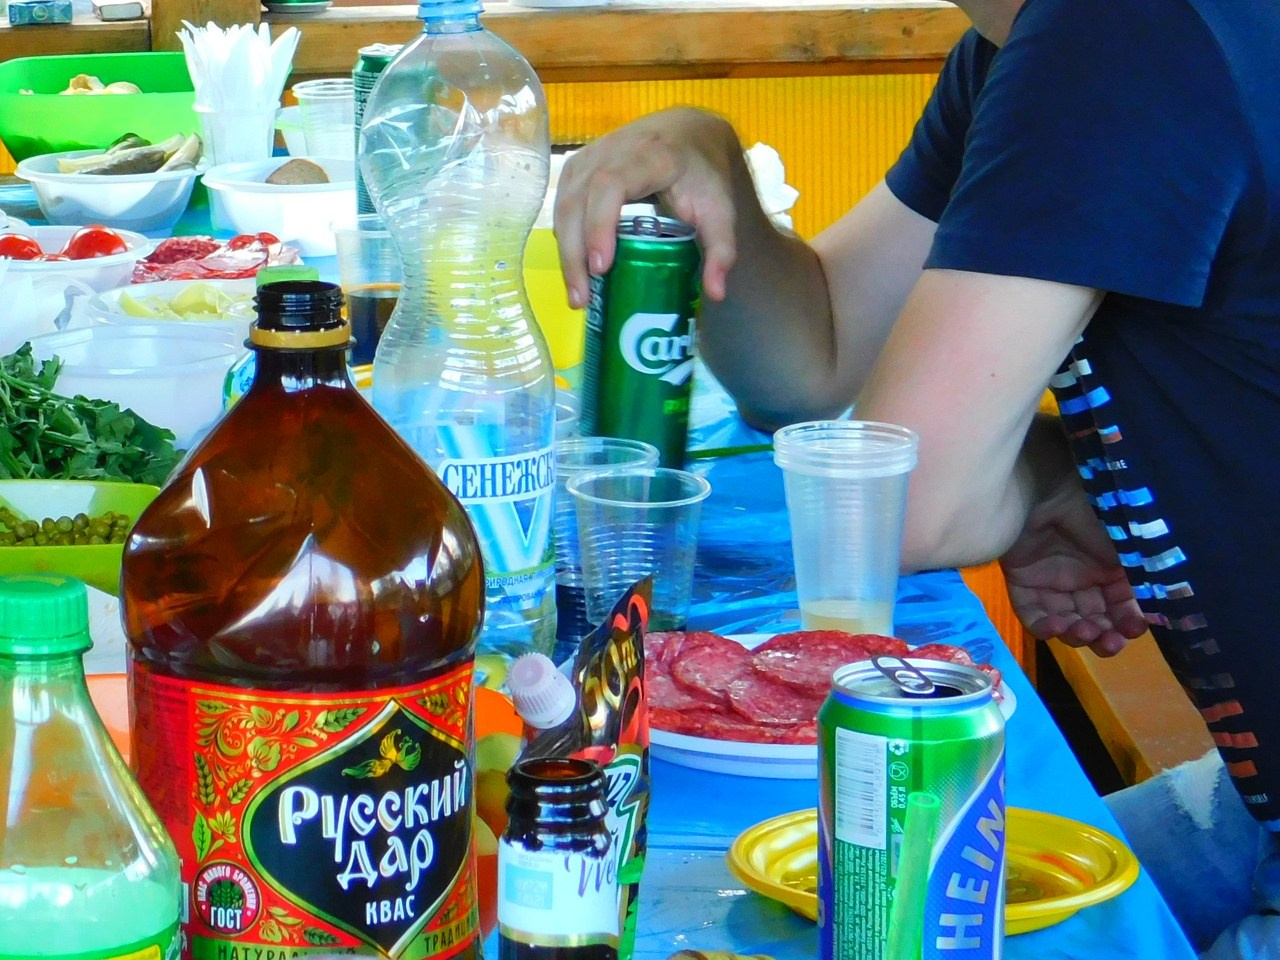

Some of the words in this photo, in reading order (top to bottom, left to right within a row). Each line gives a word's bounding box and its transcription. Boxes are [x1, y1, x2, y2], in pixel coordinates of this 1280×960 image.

[278, 759, 467, 863] Русский
[210, 906, 243, 930] ГОСТ
[365, 895, 415, 926] КВАС
